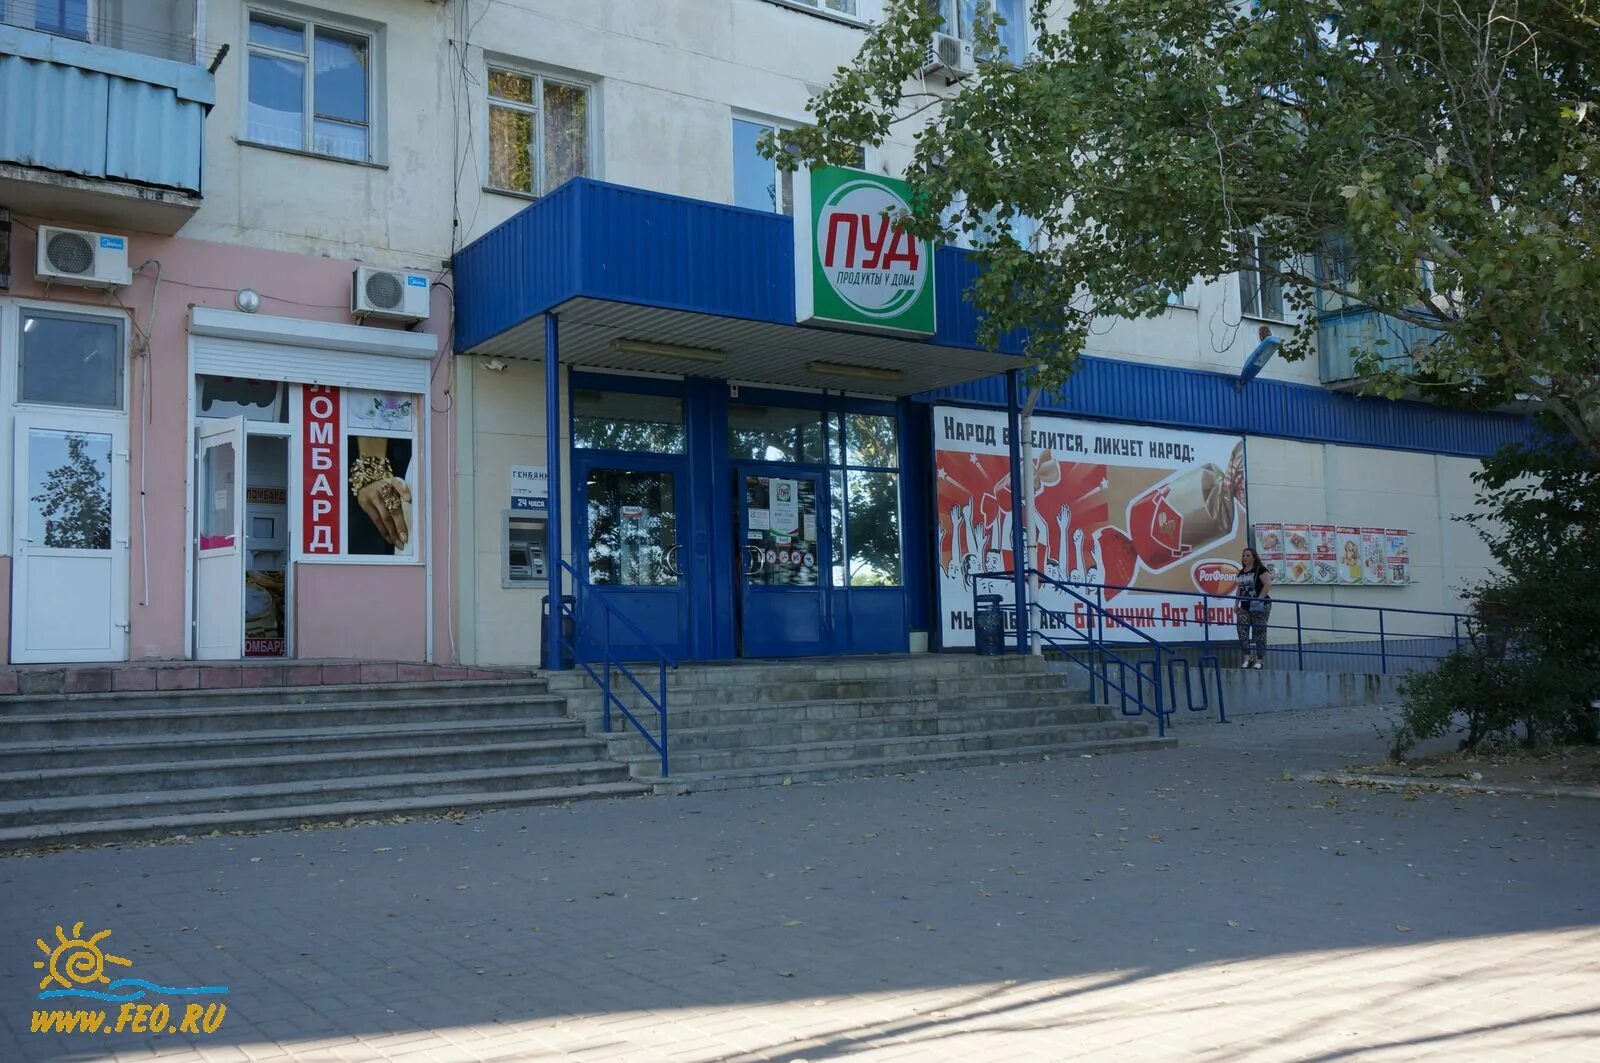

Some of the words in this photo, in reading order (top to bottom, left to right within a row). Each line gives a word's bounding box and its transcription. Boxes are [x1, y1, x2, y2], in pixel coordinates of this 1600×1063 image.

[825, 213, 919, 271] ПУД
[837, 271, 882, 285] ПРОДУКТЫ
[885, 273, 890, 285] У
[891, 273, 915, 286] ДОМА
[944, 416, 996, 447] НАРОД
[1002, 427, 1088, 455] ВЕЛИТСЯ,
[1094, 436, 1144, 457] ЛИКУЕТ
[1149, 441, 1195, 463] НАРОД:
[517, 498, 527, 507] 24
[1074, 602, 1156, 628] БАОНЧИК
[1194, 601, 1234, 627] ФРОН
[245, 640, 287, 656] ОМБАРД
